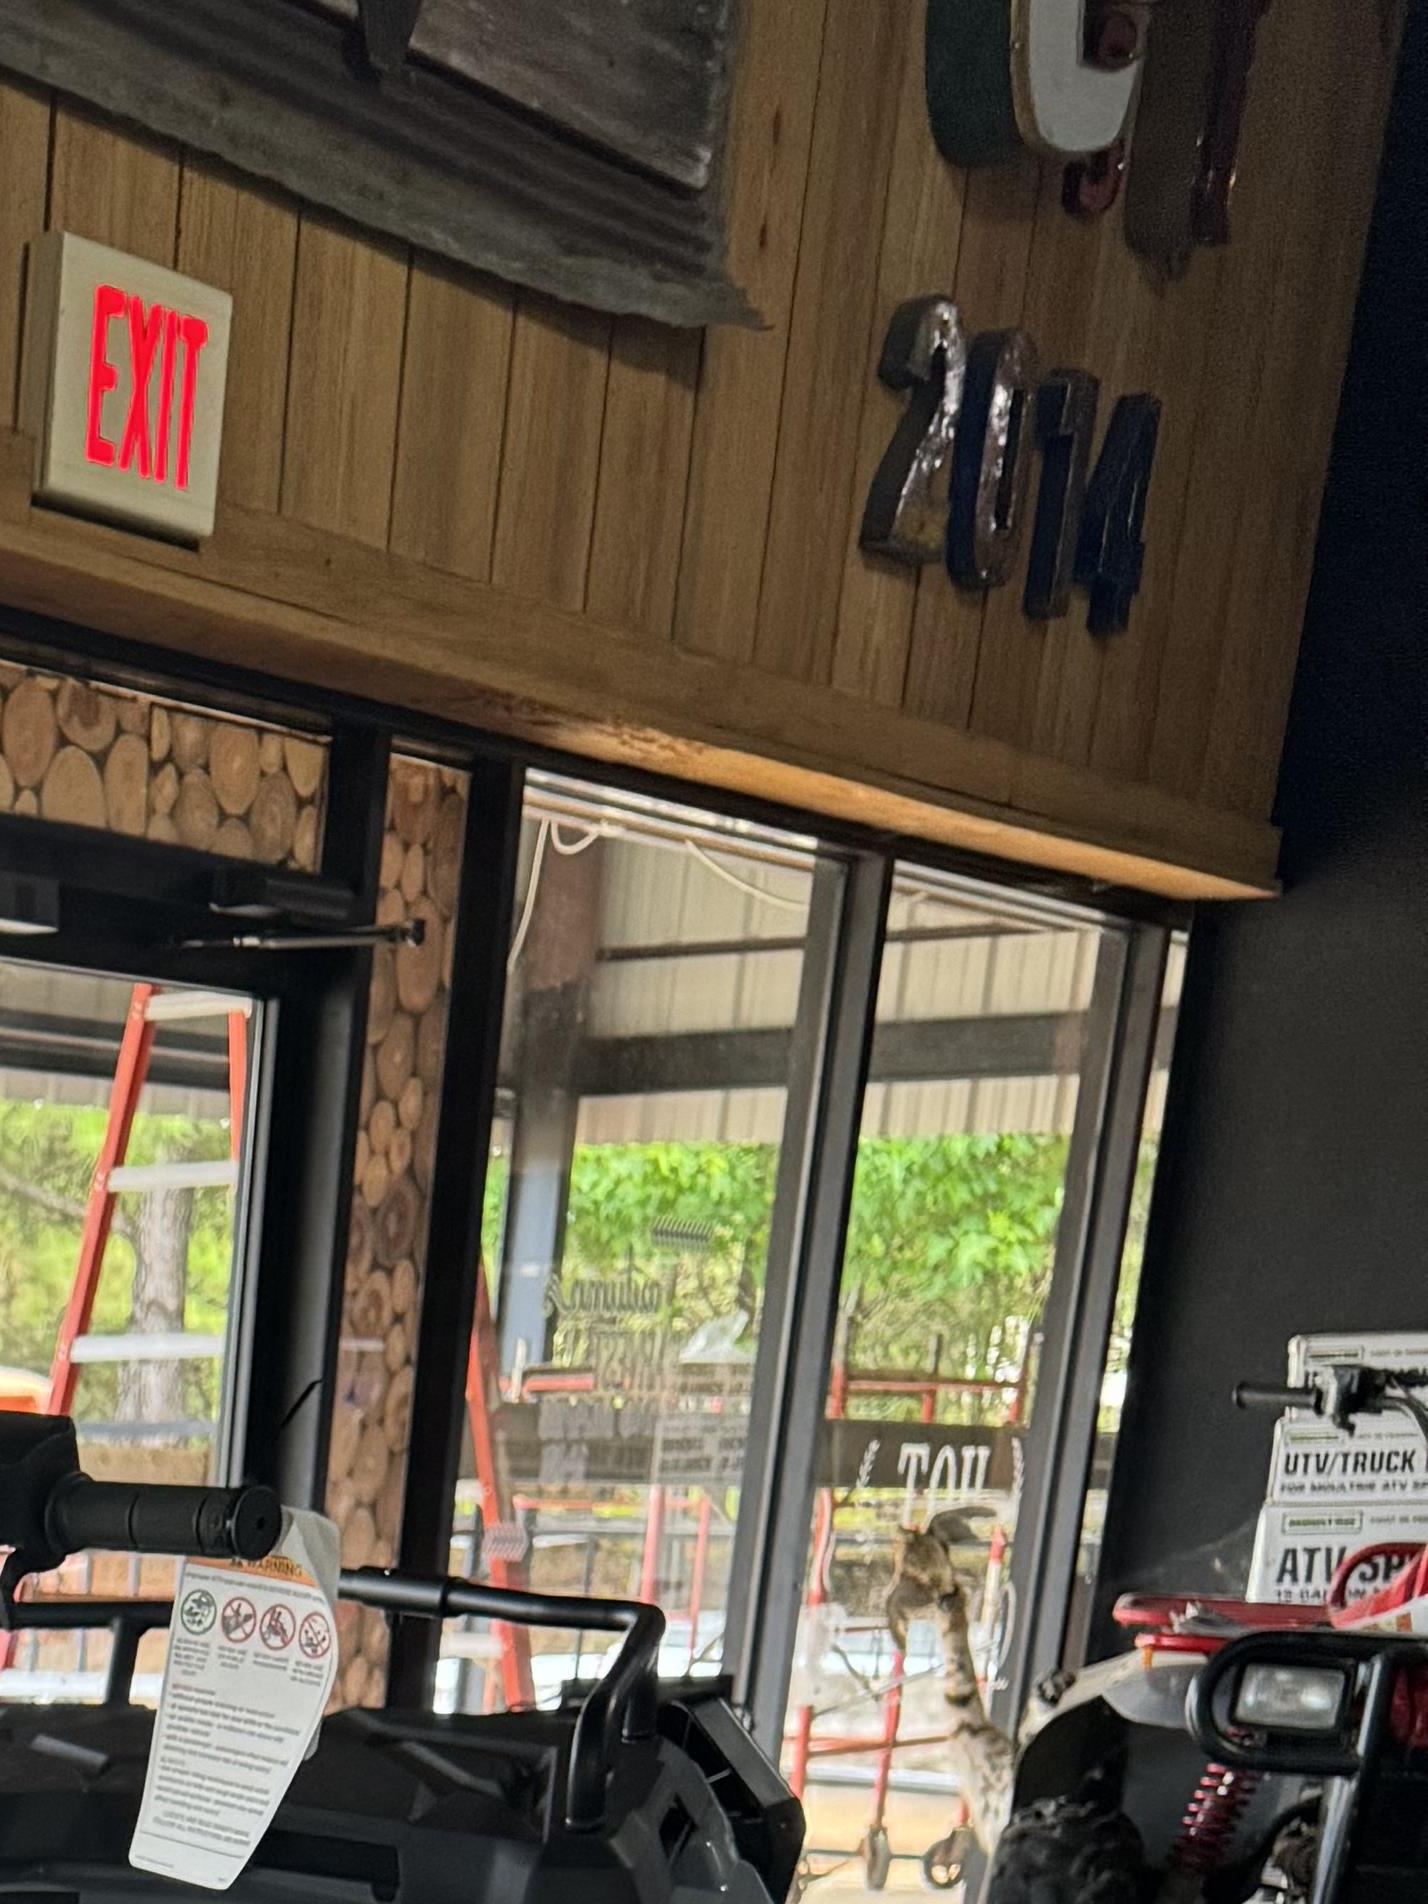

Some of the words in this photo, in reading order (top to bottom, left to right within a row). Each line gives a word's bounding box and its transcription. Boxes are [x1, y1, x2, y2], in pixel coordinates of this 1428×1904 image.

[85, 284, 209, 490] EXIT
[858, 295, 1163, 638] 2014
[1284, 1450, 1416, 1476] UTV/TRUCK
